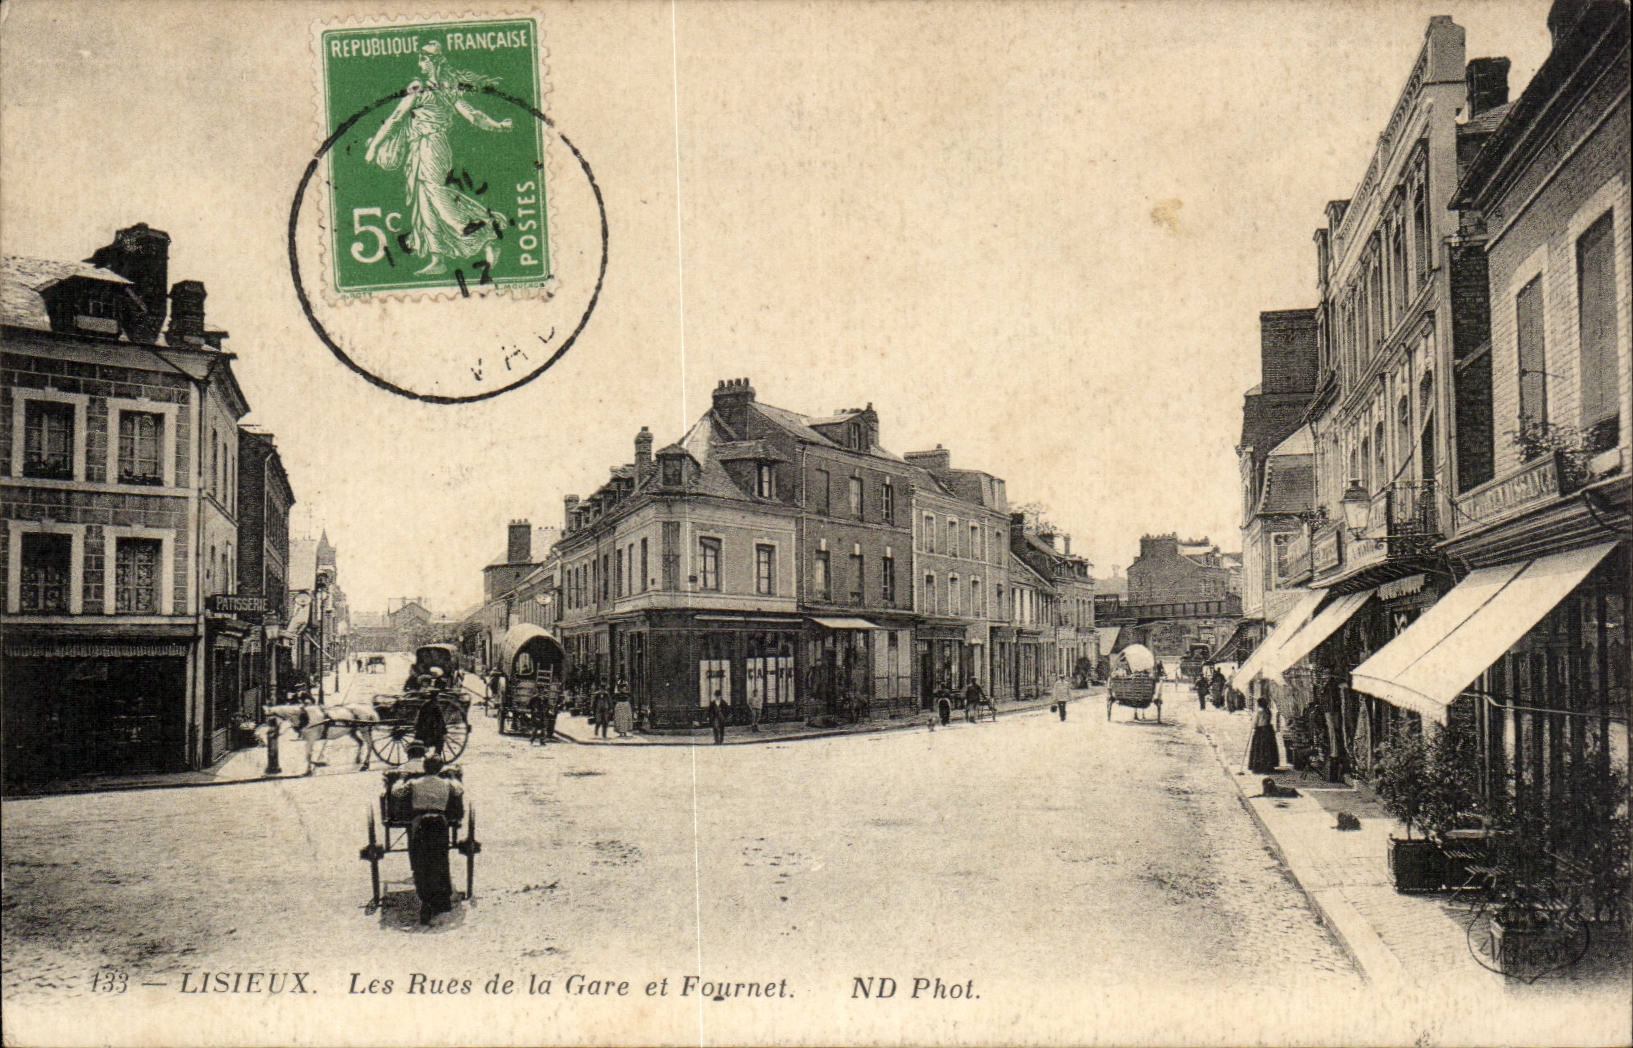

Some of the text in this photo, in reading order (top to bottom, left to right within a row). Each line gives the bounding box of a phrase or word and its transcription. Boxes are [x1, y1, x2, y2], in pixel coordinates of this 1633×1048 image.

[331, 29, 528, 58] REPUBLIQUE FRANÇAISE
[516, 180, 539, 267] POSTES
[215, 596, 269, 612] PATISSERIE
